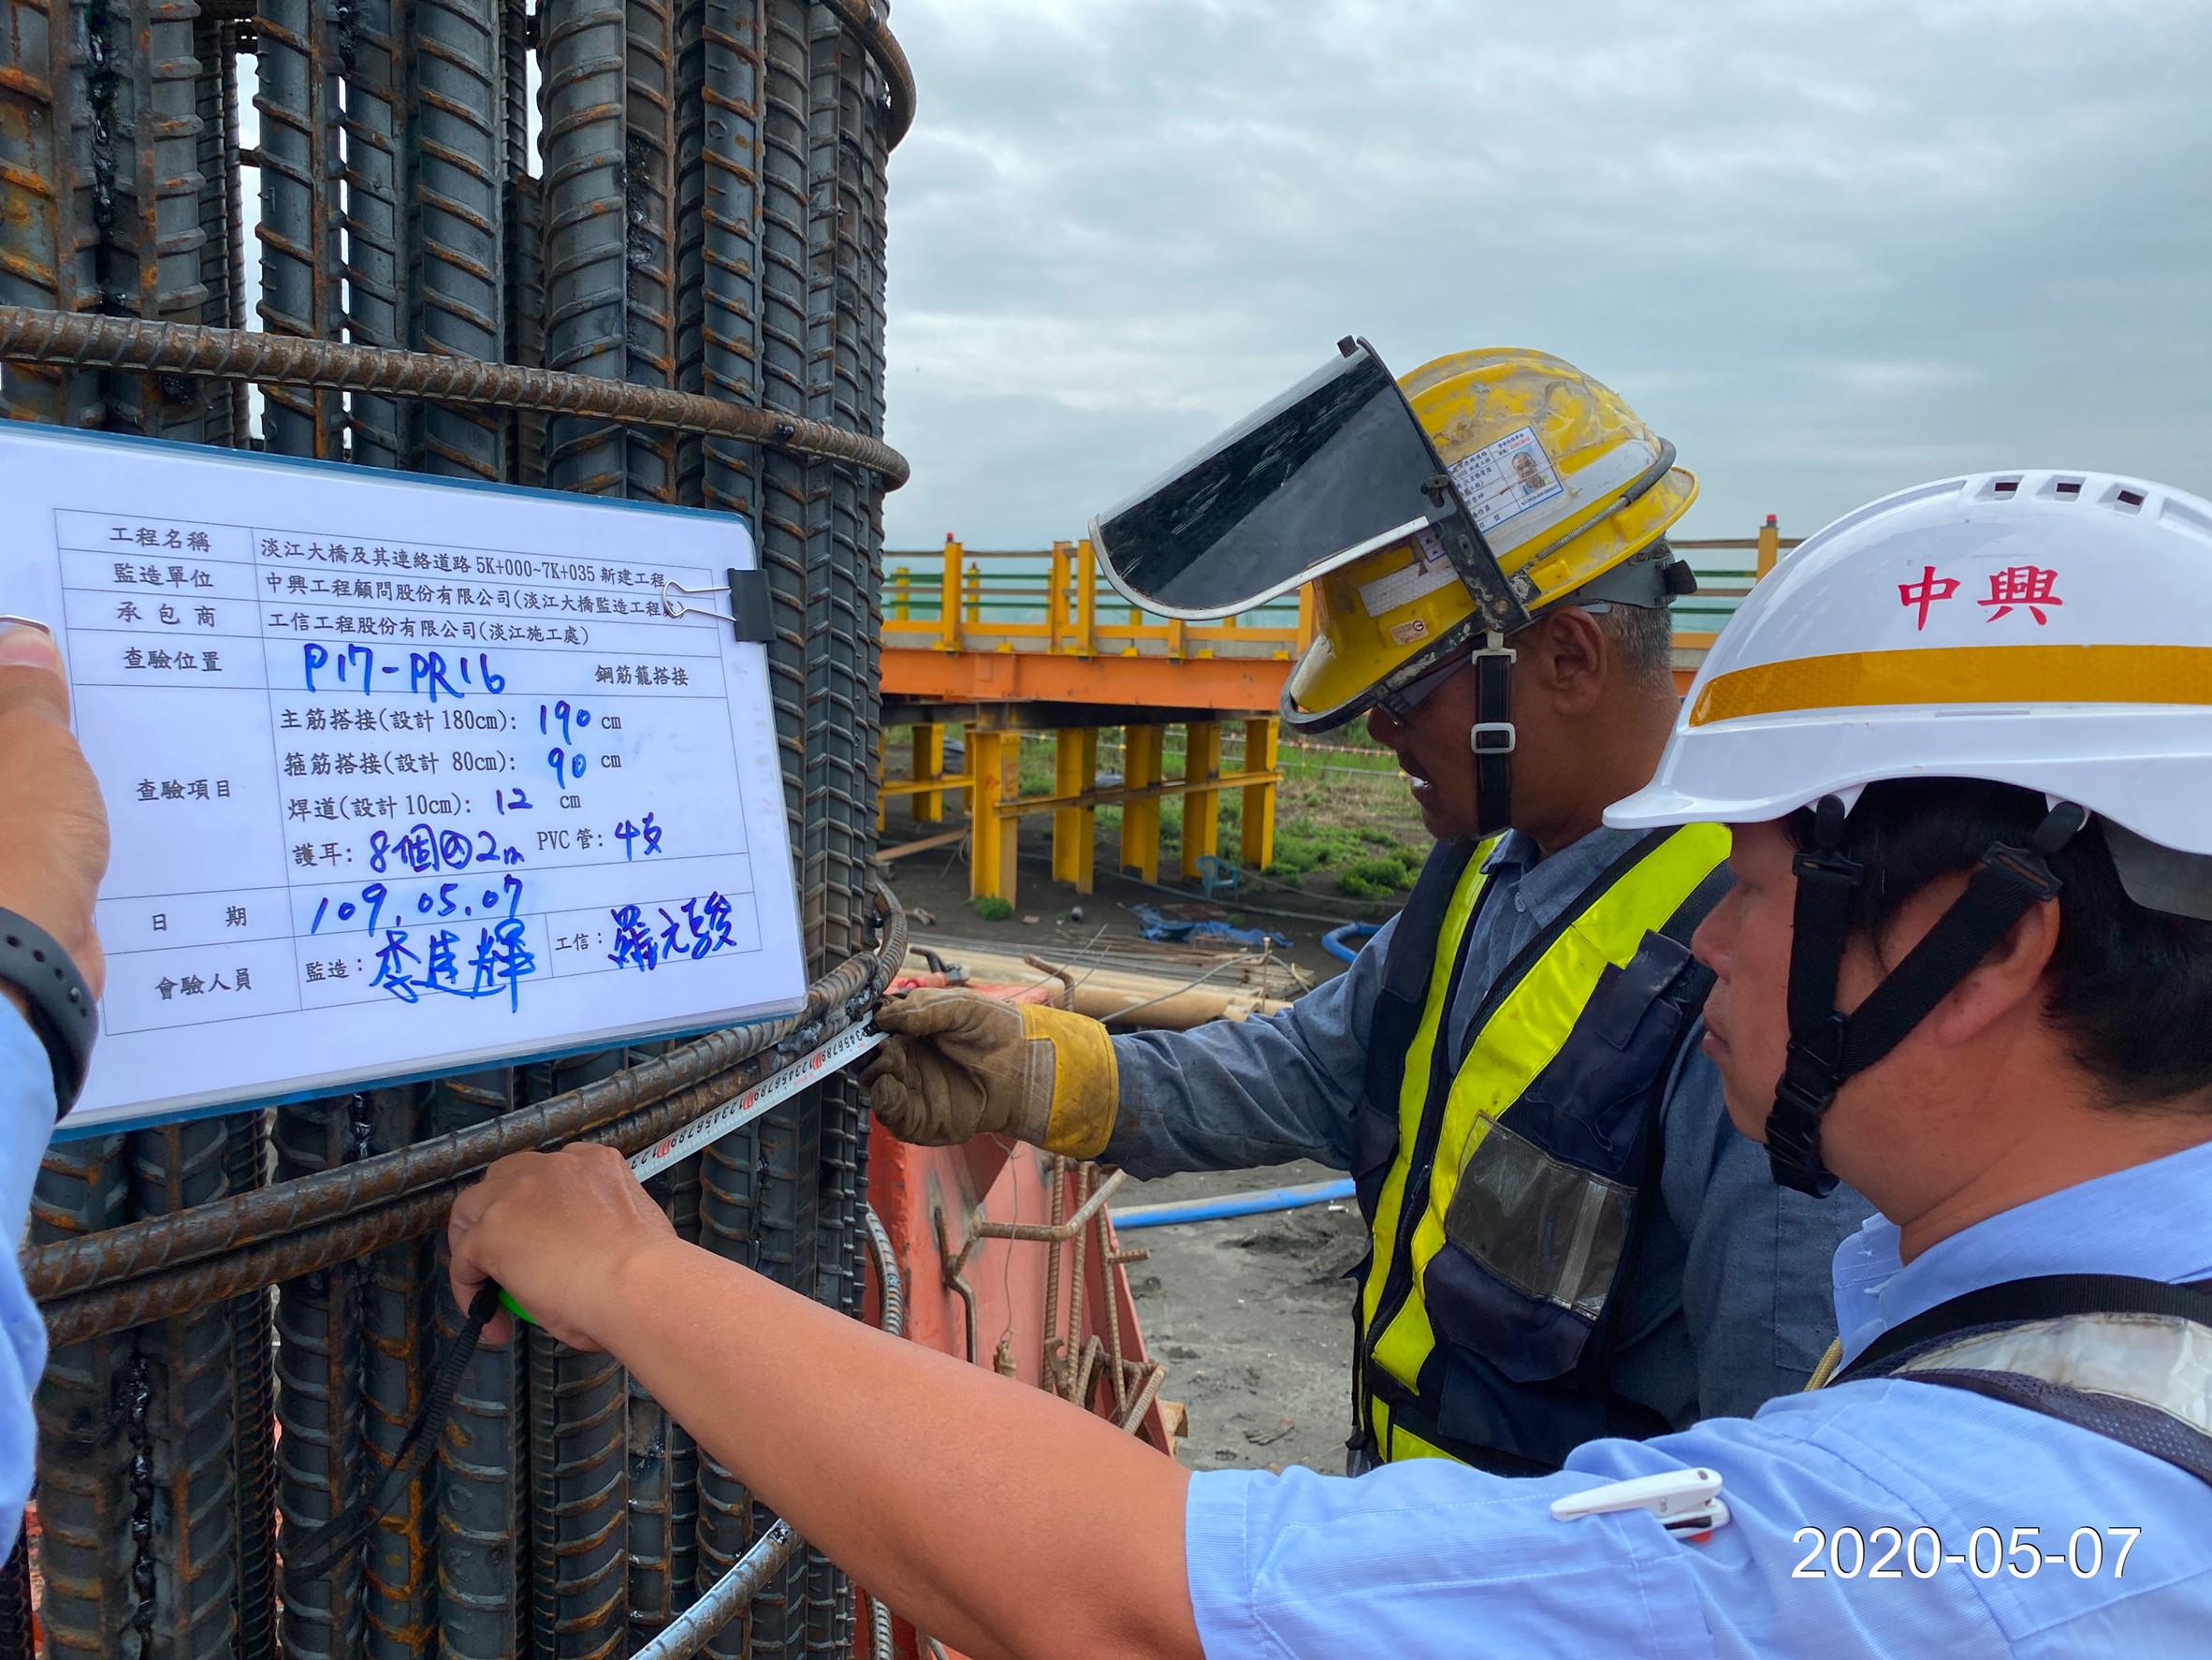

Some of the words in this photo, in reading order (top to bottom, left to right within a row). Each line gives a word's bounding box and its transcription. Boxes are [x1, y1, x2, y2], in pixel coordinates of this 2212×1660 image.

[109, 527, 211, 552] 工程名稱
[113, 563, 214, 589] 監造單位
[260, 538, 470, 574] 淡江大橋及其連絡道路
[601, 566, 665, 588] 新建工程
[1898, 565, 2063, 631] 中興
[117, 601, 216, 628] 承包商
[268, 612, 589, 646] 工信工程股份有限公司(淡江施工處)
[124, 647, 223, 672] 查驗位置
[595, 664, 690, 687] 鋼筋籠搭接
[540, 700, 591, 745] 190
[602, 714, 622, 730] cm
[547, 748, 587, 789] 90
[601, 754, 622, 768] cm
[137, 779, 231, 802] 查驗項目
[496, 788, 532, 815] 12
[560, 794, 582, 808] cm
[537, 830, 570, 851] PVC
[154, 968, 252, 1000] 會驗人員
